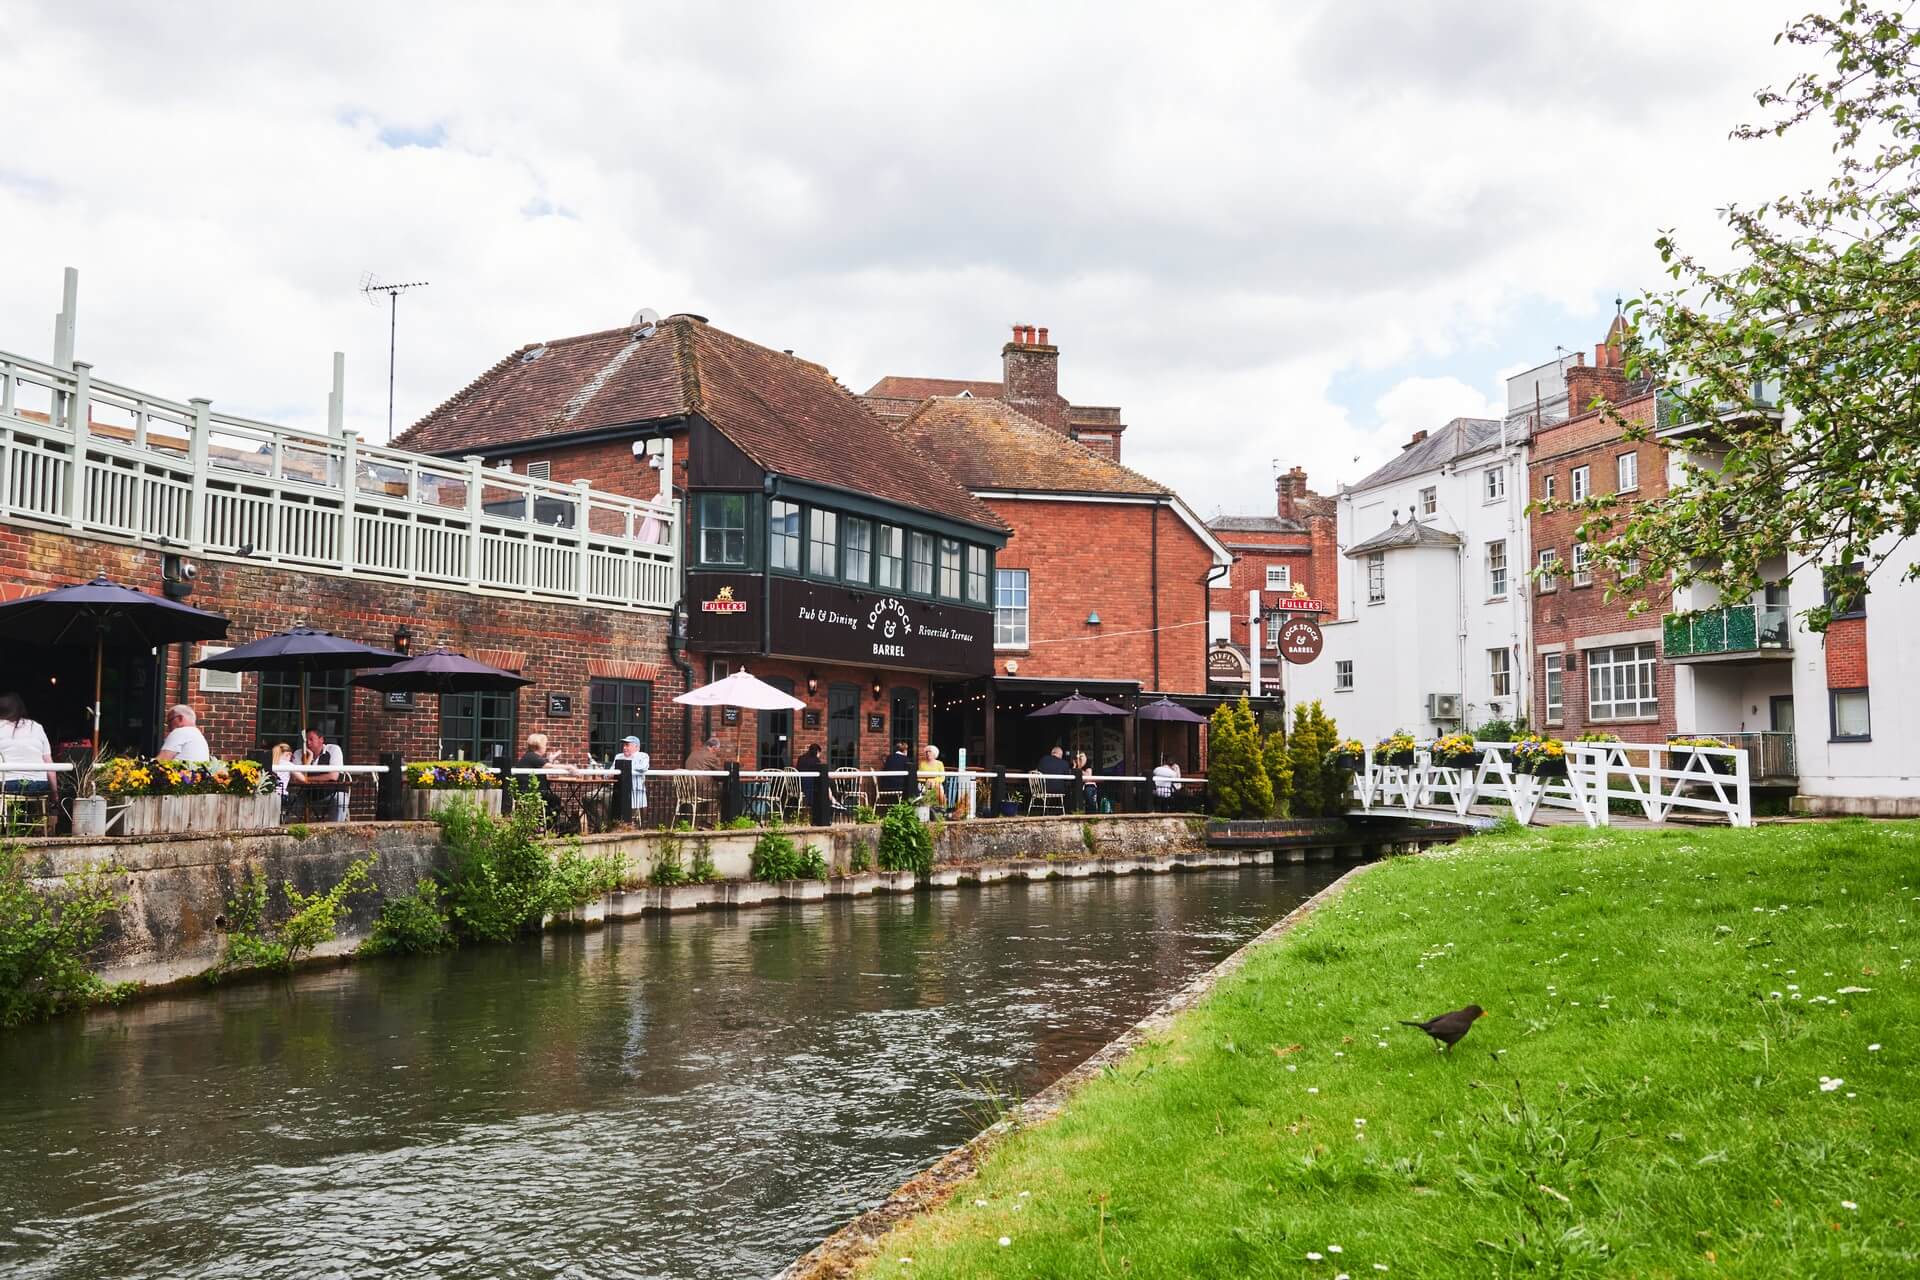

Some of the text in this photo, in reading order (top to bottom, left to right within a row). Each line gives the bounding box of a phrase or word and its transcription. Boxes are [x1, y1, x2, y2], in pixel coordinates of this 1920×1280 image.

[798, 606, 858, 630] Pub & Dining
[867, 598, 912, 635] LOCK STOCK
[883, 620, 897, 639] &
[918, 624, 974, 642] Riverside Terrace
[1283, 623, 1319, 642] LOCK STOCK
[1296, 635, 1306, 645] &
[872, 643, 905, 657] BARREL
[1288, 646, 1314, 654] BARREL
[1208, 652, 1240, 668] RIFFINS
